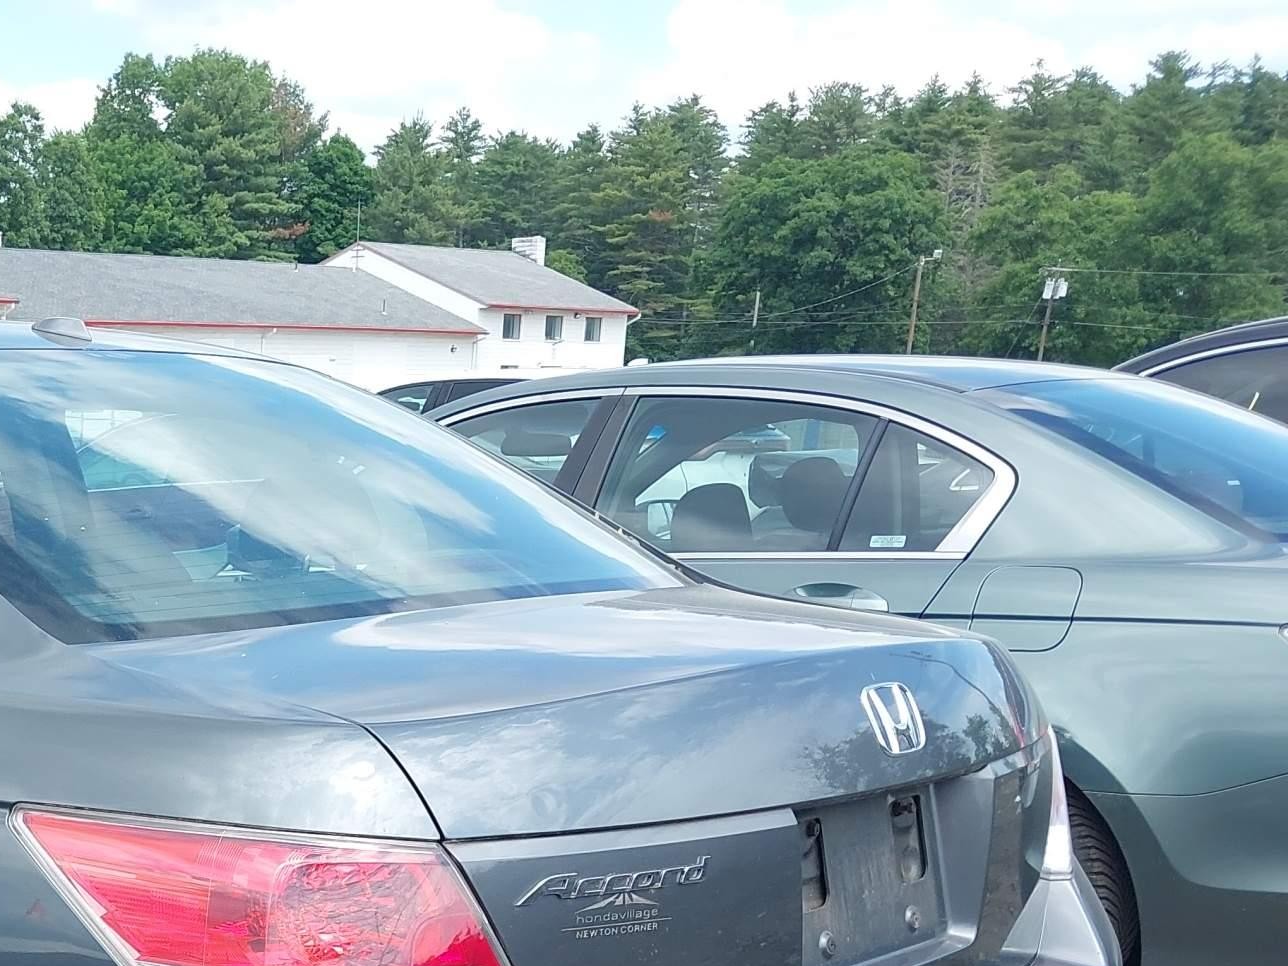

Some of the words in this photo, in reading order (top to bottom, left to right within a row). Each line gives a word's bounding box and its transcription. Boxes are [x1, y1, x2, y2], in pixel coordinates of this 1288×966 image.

[514, 856, 712, 906] Accord
[575, 908, 659, 925] hondavillage
[575, 927, 618, 939] NEWTON
[620, 922, 658, 935] CORNER
